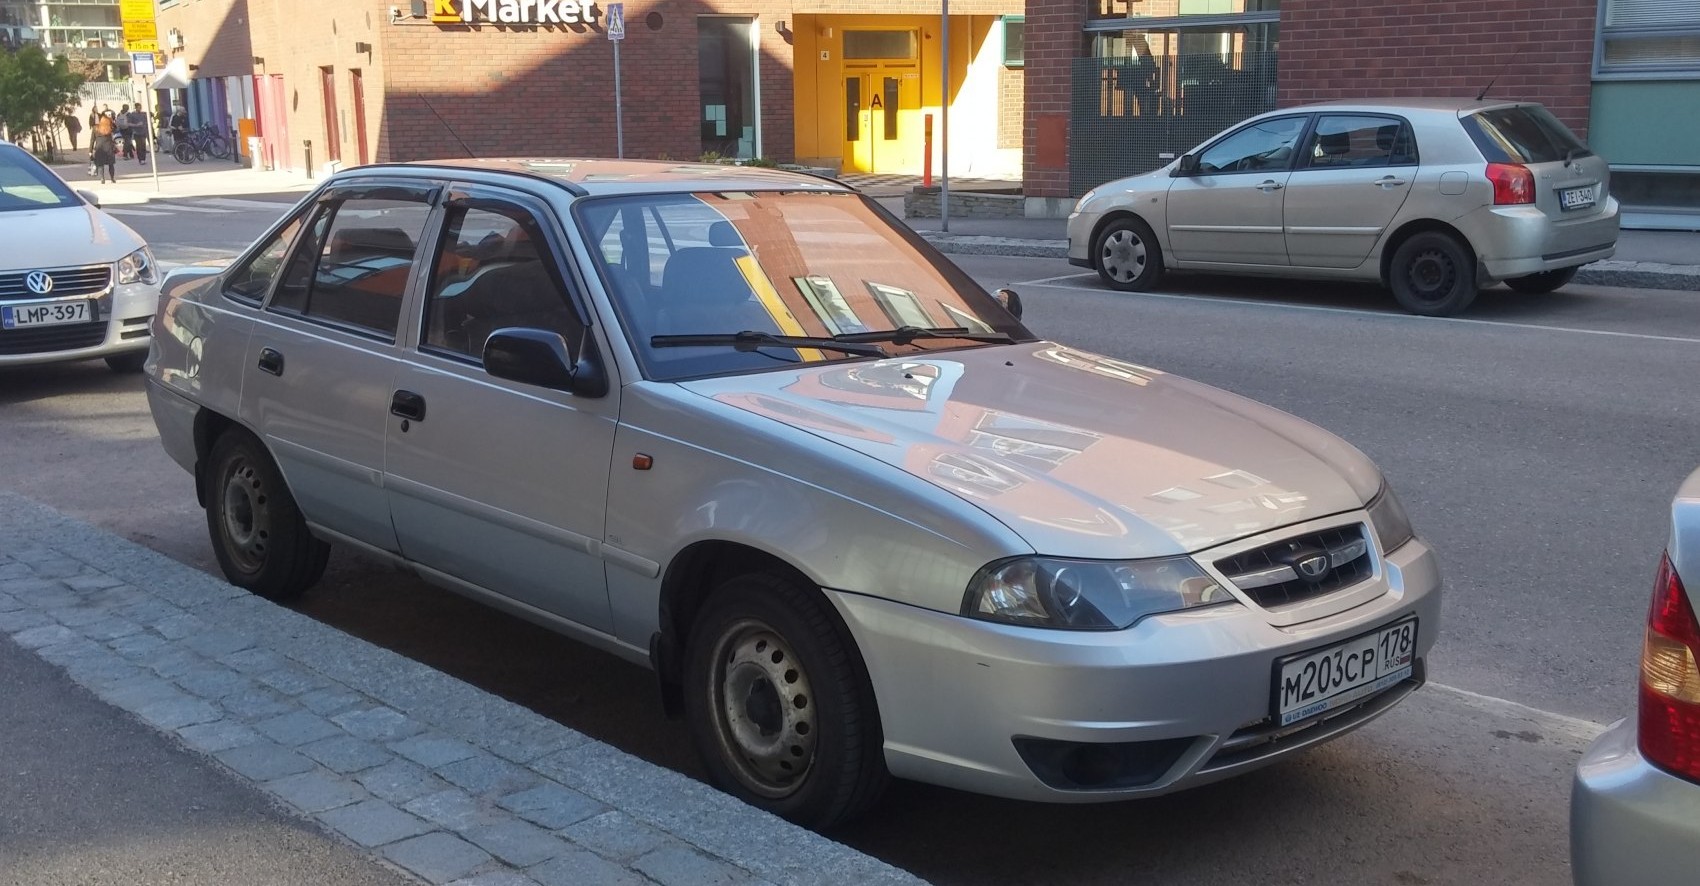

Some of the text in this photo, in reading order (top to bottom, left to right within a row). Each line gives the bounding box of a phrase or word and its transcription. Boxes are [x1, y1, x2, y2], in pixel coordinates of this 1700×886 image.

[871, 93, 882, 108] A
[1380, 625, 1410, 660] 178
[1384, 655, 1400, 671] RUS
